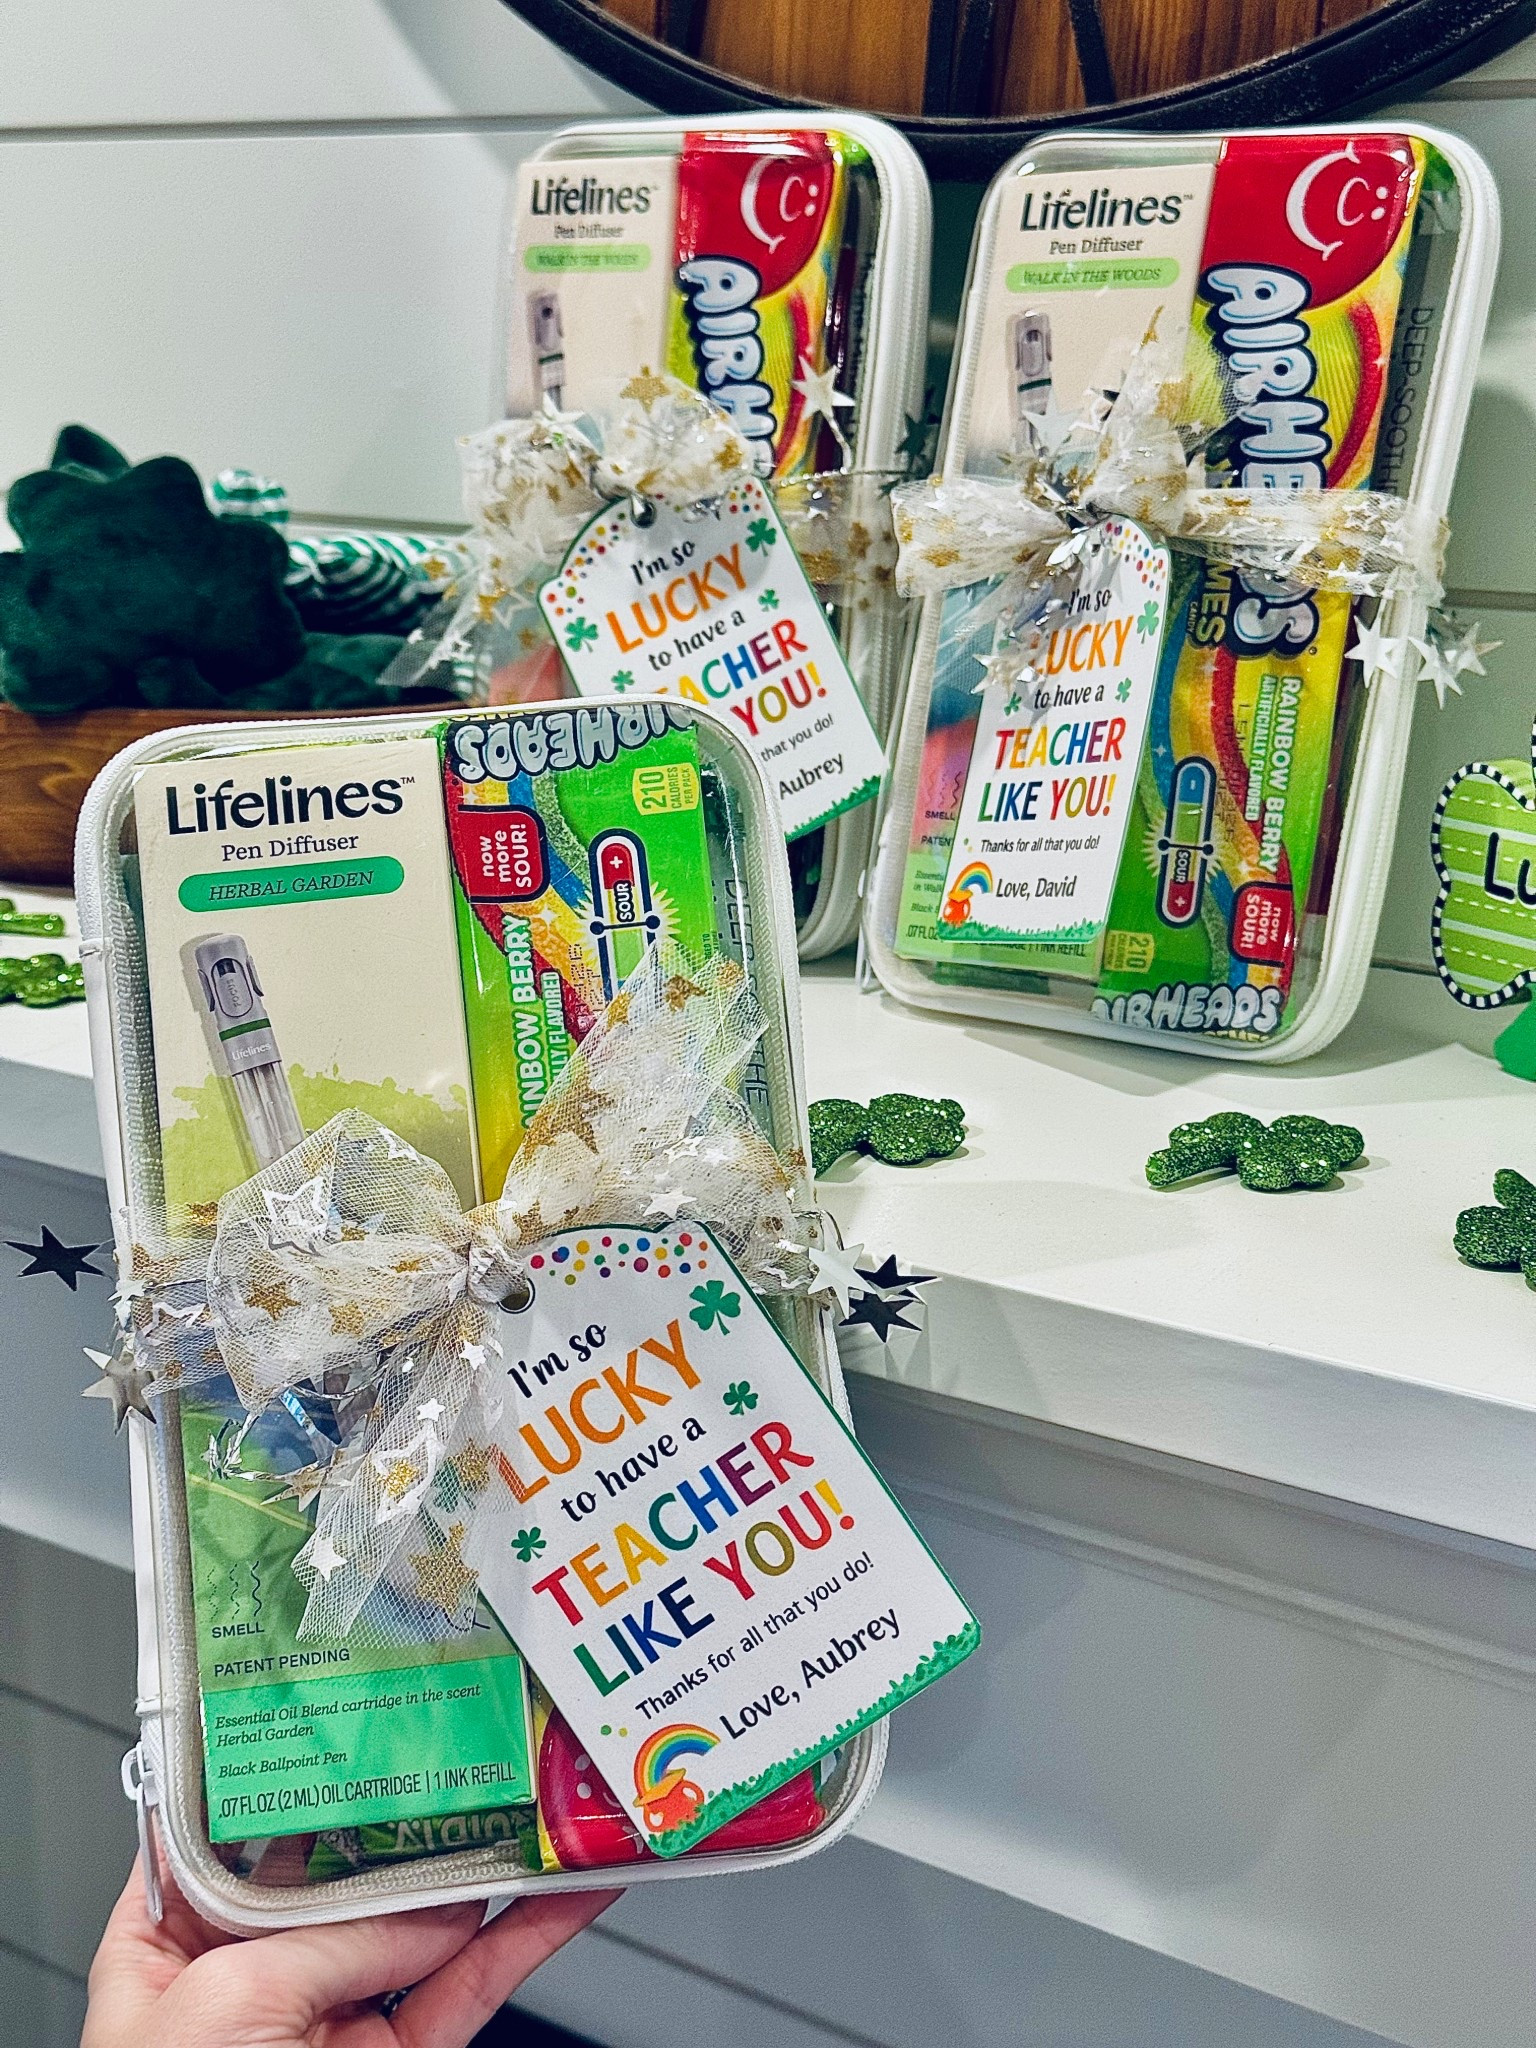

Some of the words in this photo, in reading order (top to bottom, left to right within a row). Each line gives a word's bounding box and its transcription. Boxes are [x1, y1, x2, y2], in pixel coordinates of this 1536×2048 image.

[1050, 241, 1076, 255] Pen
[1082, 237, 1144, 253] Diffuser
[1023, 271, 1057, 285] WALK
[1082, 269, 1109, 282] THE
[1112, 267, 1161, 281] WOODS
[630, 556, 669, 586] I'm
[671, 540, 695, 565] so
[606, 543, 747, 653] LUCKY
[1068, 589, 1090, 615] I'm
[1094, 589, 1111, 611] so
[649, 651, 671, 672] to
[674, 627, 727, 658] have
[732, 611, 745, 627] a
[730, 661, 826, 736] YOU!
[1034, 689, 1050, 709] to
[1054, 685, 1092, 707] have
[1095, 685, 1104, 701] a
[1252, 676, 1276, 756] ARTIFICIALLY
[761, 739, 787, 762] that
[788, 728, 812, 750] you
[815, 714, 834, 733] do!
[995, 717, 1127, 770] TEACHER
[1268, 676, 1302, 790] RAINBOW
[639, 771, 667, 809] 210
[667, 767, 682, 808] CALORIES
[682, 768, 692, 787] PACK
[684, 789, 694, 804] PER
[779, 753, 844, 800] Aubrey
[977, 780, 1042, 822] LIKE
[1049, 773, 1116, 821] YOU!
[1245, 760, 1265, 822] FLAVORED
[925, 811, 955, 820] SMELL
[1259, 797, 1284, 872] BERRY
[222, 844, 263, 862] Pen
[269, 835, 359, 857] Diffuser
[480, 836, 495, 877] now
[495, 830, 512, 882] more
[510, 824, 532, 888] SOUR!
[921, 836, 953, 846] PATEN
[981, 838, 1013, 853] Thanks
[1016, 837, 1030, 853] for
[1032, 837, 1043, 851] all
[1045, 837, 1063, 851] that
[1066, 838, 1081, 854] you
[1084, 835, 1100, 849] do!
[208, 880, 287, 901] HERBAL
[292, 870, 374, 893] GARDEN
[1175, 849, 1189, 883] SOUR
[618, 882, 632, 920] SOUR
[995, 878, 1031, 900] Love,
[1034, 876, 1077, 897] David
[1257, 901, 1272, 945] more
[1270, 907, 1282, 942] now
[505, 915, 535, 1003] BERRY
[1127, 936, 1150, 969] 210
[543, 972, 566, 1044] FLAVORED
[231, 1042, 271, 1061] Lifelines
[507, 1352, 569, 1399] I'm
[569, 1324, 606, 1362] so
[490, 1319, 701, 1504] LUCKY
[561, 1490, 596, 1522] to
[595, 1439, 678, 1497] have
[682, 1417, 706, 1441] a
[532, 1421, 815, 1626] TEACHER
[573, 1577, 715, 1697] LIKE
[703, 1478, 855, 1601] YOU!
[211, 1622, 265, 1639] SMELL
[634, 1667, 709, 1721] Thanks
[707, 1646, 736, 1676] for
[740, 1626, 764, 1653] all
[764, 1601, 806, 1636] that
[805, 1580, 843, 1615] you
[843, 1552, 875, 1583] do!
[214, 1658, 275, 1677] PATENT
[279, 1648, 350, 1669] PENDING
[718, 1683, 802, 1739] Love,
[800, 1608, 902, 1688] Aubrey
[215, 1709, 276, 1729] Essential
[278, 1706, 298, 1721] Oil
[301, 1701, 339, 1718] Blend
[342, 1695, 402, 1713] cartridge
[406, 1692, 418, 1704] in
[422, 1689, 443, 1702] the
[447, 1684, 481, 1699] scent
[216, 1731, 262, 1748] Herbal
[265, 1724, 315, 1741] Garden
[218, 1761, 257, 1779] Black
[259, 1754, 320, 1773] Ballpoint
[323, 1752, 348, 1765] Pen
[345, 1773, 421, 1801] CARTRIDGE
[434, 1771, 441, 1790] 1
[444, 1767, 469, 1789] INK
[471, 1761, 517, 1786] REFILL
